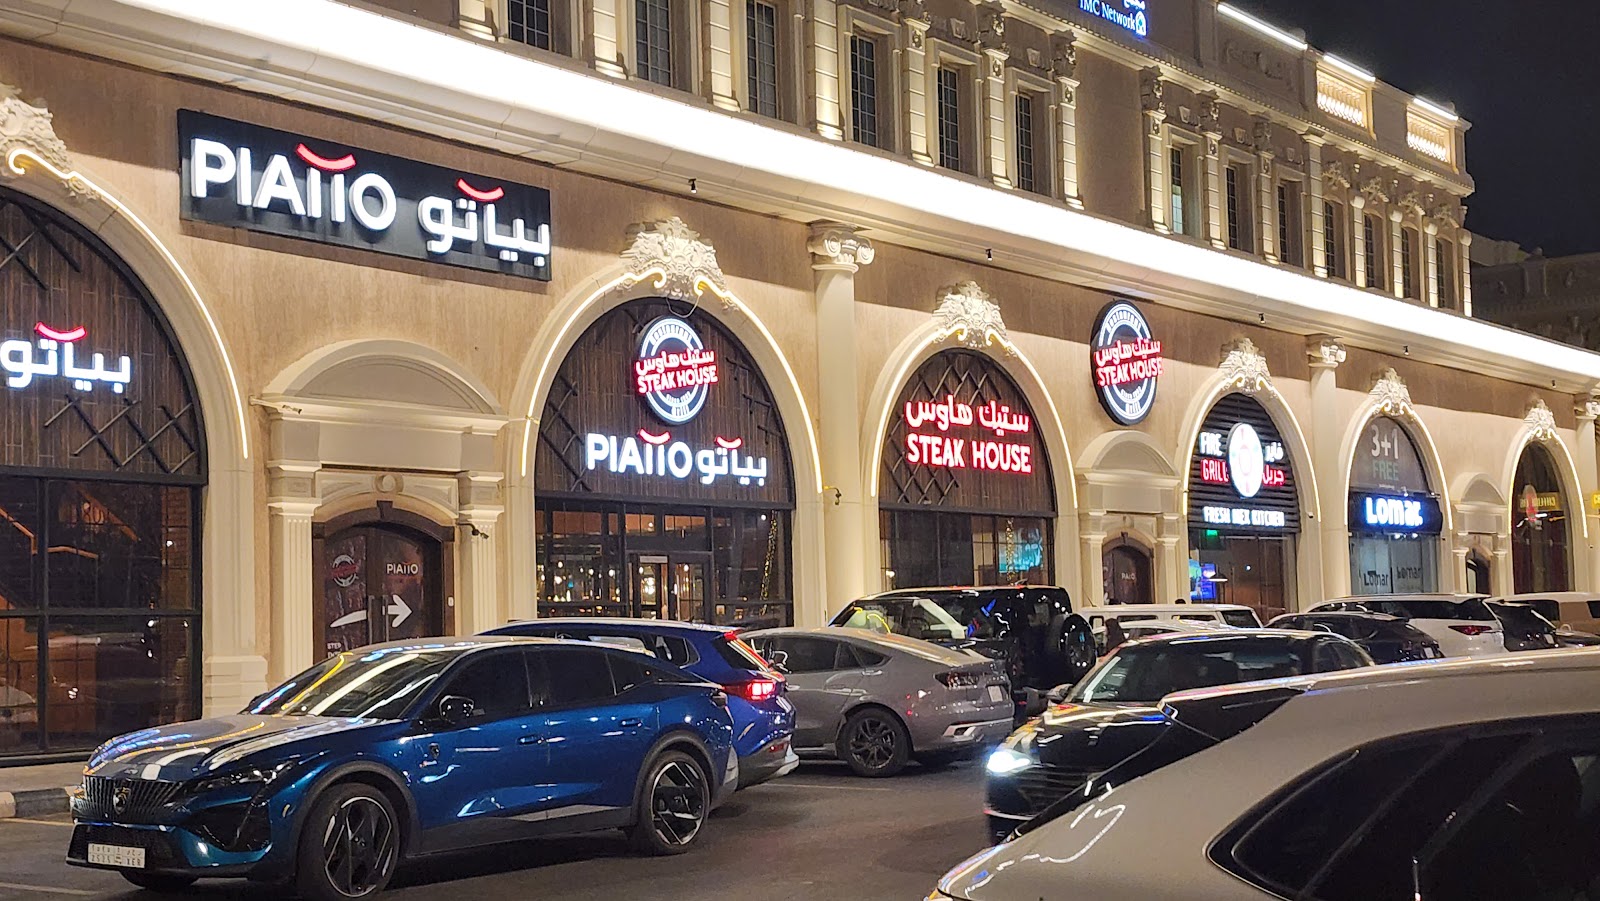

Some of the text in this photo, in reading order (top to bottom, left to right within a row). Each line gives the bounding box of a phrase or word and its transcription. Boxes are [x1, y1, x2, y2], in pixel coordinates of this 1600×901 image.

[1101, 2, 1136, 31] Network
[637, 365, 719, 394] STEAK HOUSE
[1097, 356, 1164, 387] STEAK HOUSE
[905, 395, 1029, 437] ستيك هاوس
[907, 432, 1032, 474] STEAK HOUSE
[1371, 424, 1399, 460] 3+1
[1372, 460, 1399, 482] FREE
